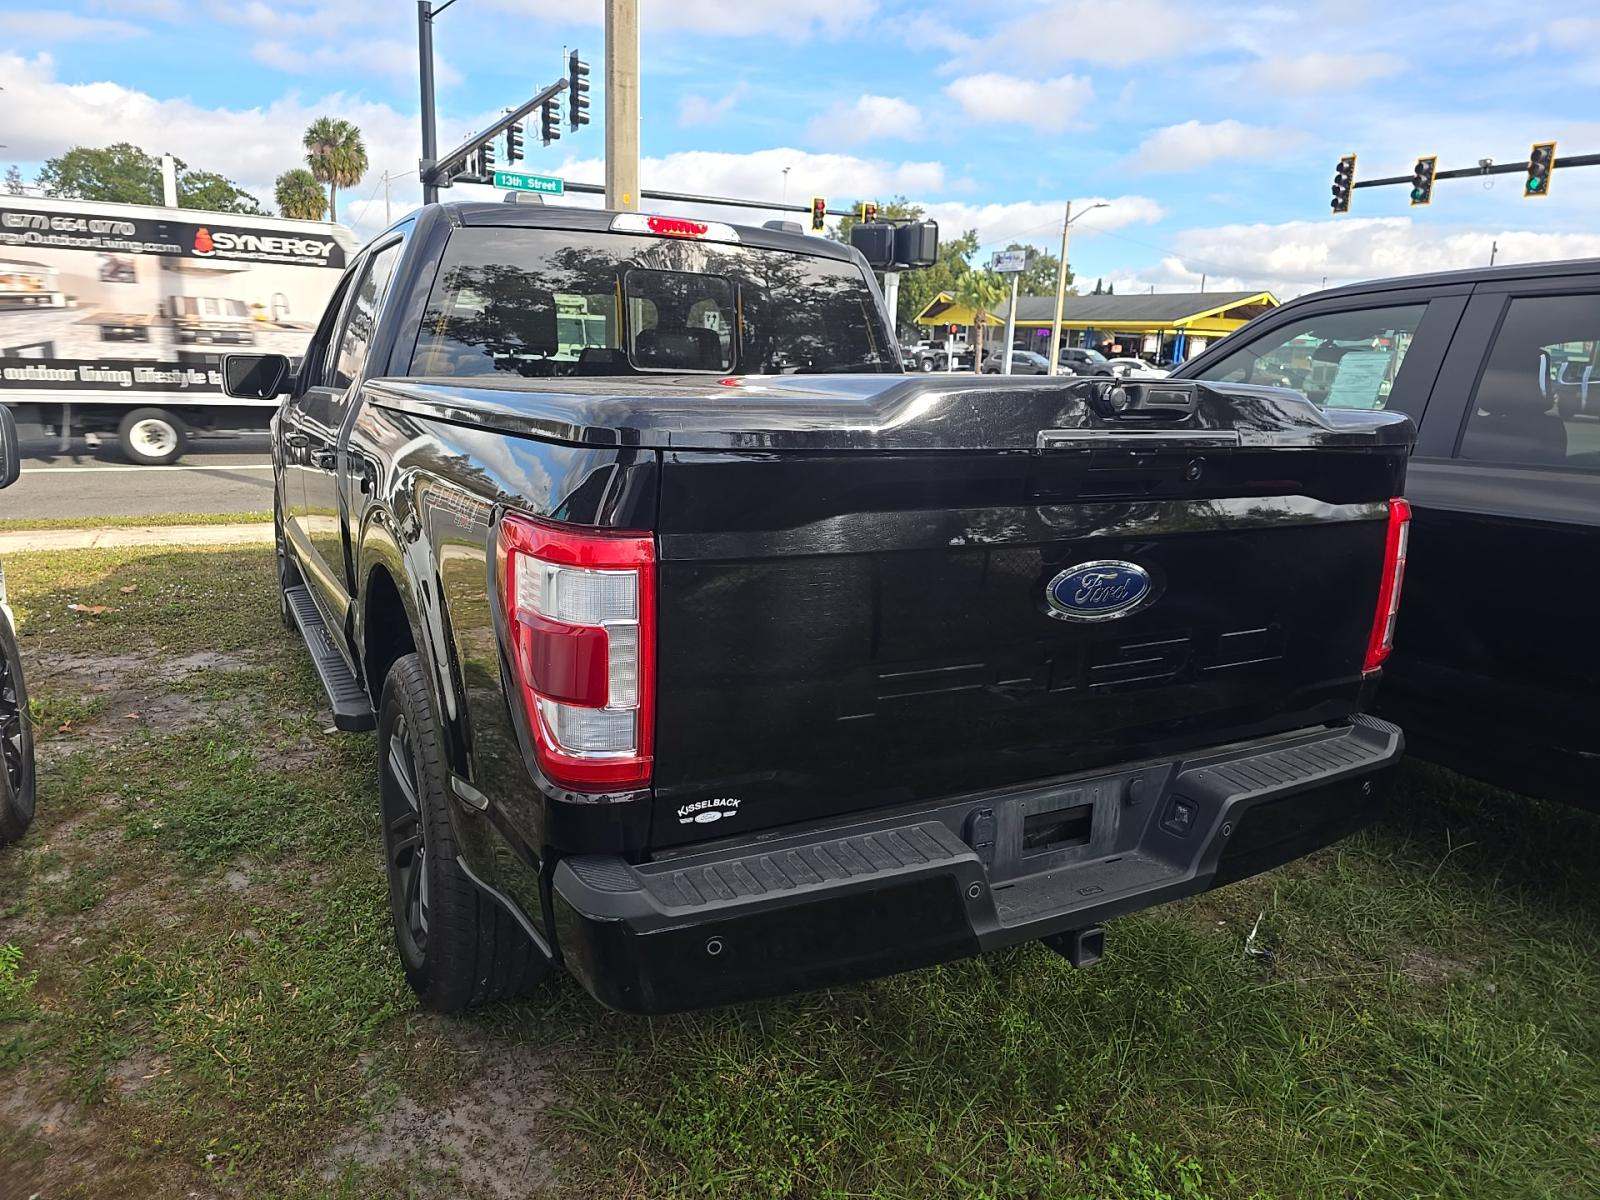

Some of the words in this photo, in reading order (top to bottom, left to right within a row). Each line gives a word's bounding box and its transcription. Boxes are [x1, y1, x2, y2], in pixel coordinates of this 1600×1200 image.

[501, 174, 522, 187] 13th
[527, 178, 557, 191] Street
[212, 232, 336, 257] SYNERGY
[79, 366, 132, 387] living
[133, 367, 206, 388] lifestyle
[1074, 572, 1131, 605] Ford
[677, 798, 741, 817] KISSELBACK
